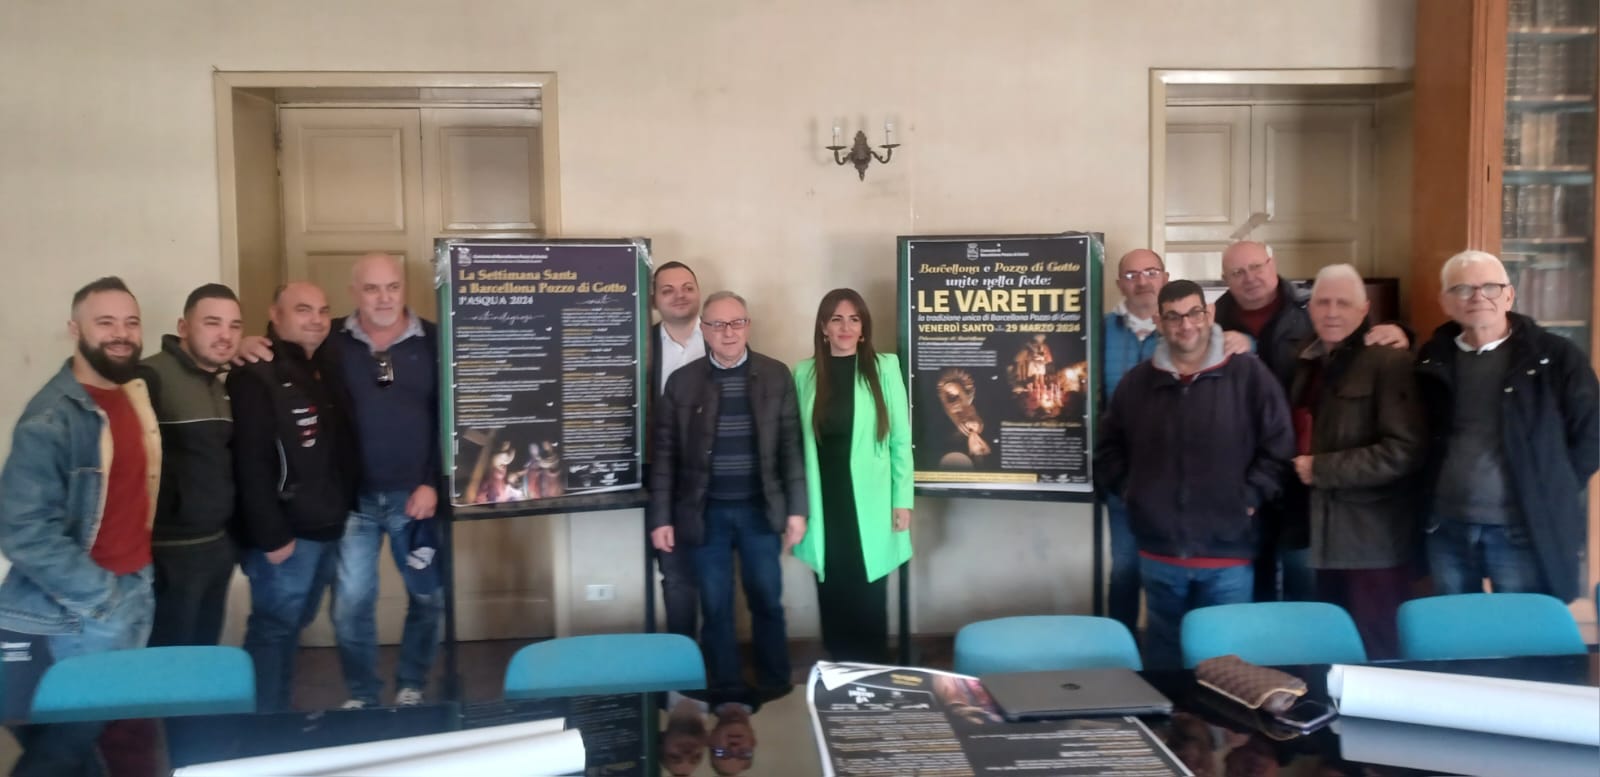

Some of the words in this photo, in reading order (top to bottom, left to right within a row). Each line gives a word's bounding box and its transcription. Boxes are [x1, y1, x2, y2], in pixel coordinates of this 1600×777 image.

[919, 263, 980, 275] Barcellona
[983, 265, 991, 273] e
[994, 262, 1028, 274] Pozzo
[1031, 262, 1044, 272] di
[1047, 261, 1080, 272] Gotto
[459, 269, 475, 281] La
[477, 269, 541, 281] Settimana
[543, 269, 577, 281] Santa
[945, 275, 979, 288] unite
[982, 275, 1014, 289] nella
[1018, 274, 1052, 288] fede:
[459, 285, 467, 294] a
[470, 282, 536, 294] Barcellona
[538, 282, 576, 293] Pozzo
[577, 282, 590, 293] di
[591, 281, 627, 293] Gotto
[459, 296, 507, 306] PASQUA
[918, 290, 950, 312] LE
[955, 288, 1081, 312] VARETTE
[918, 322, 960, 333] VENERDÌ
[961, 323, 995, 333] SANTO
[1005, 323, 1018, 333] 29
[1019, 323, 1055, 333] MARZO
